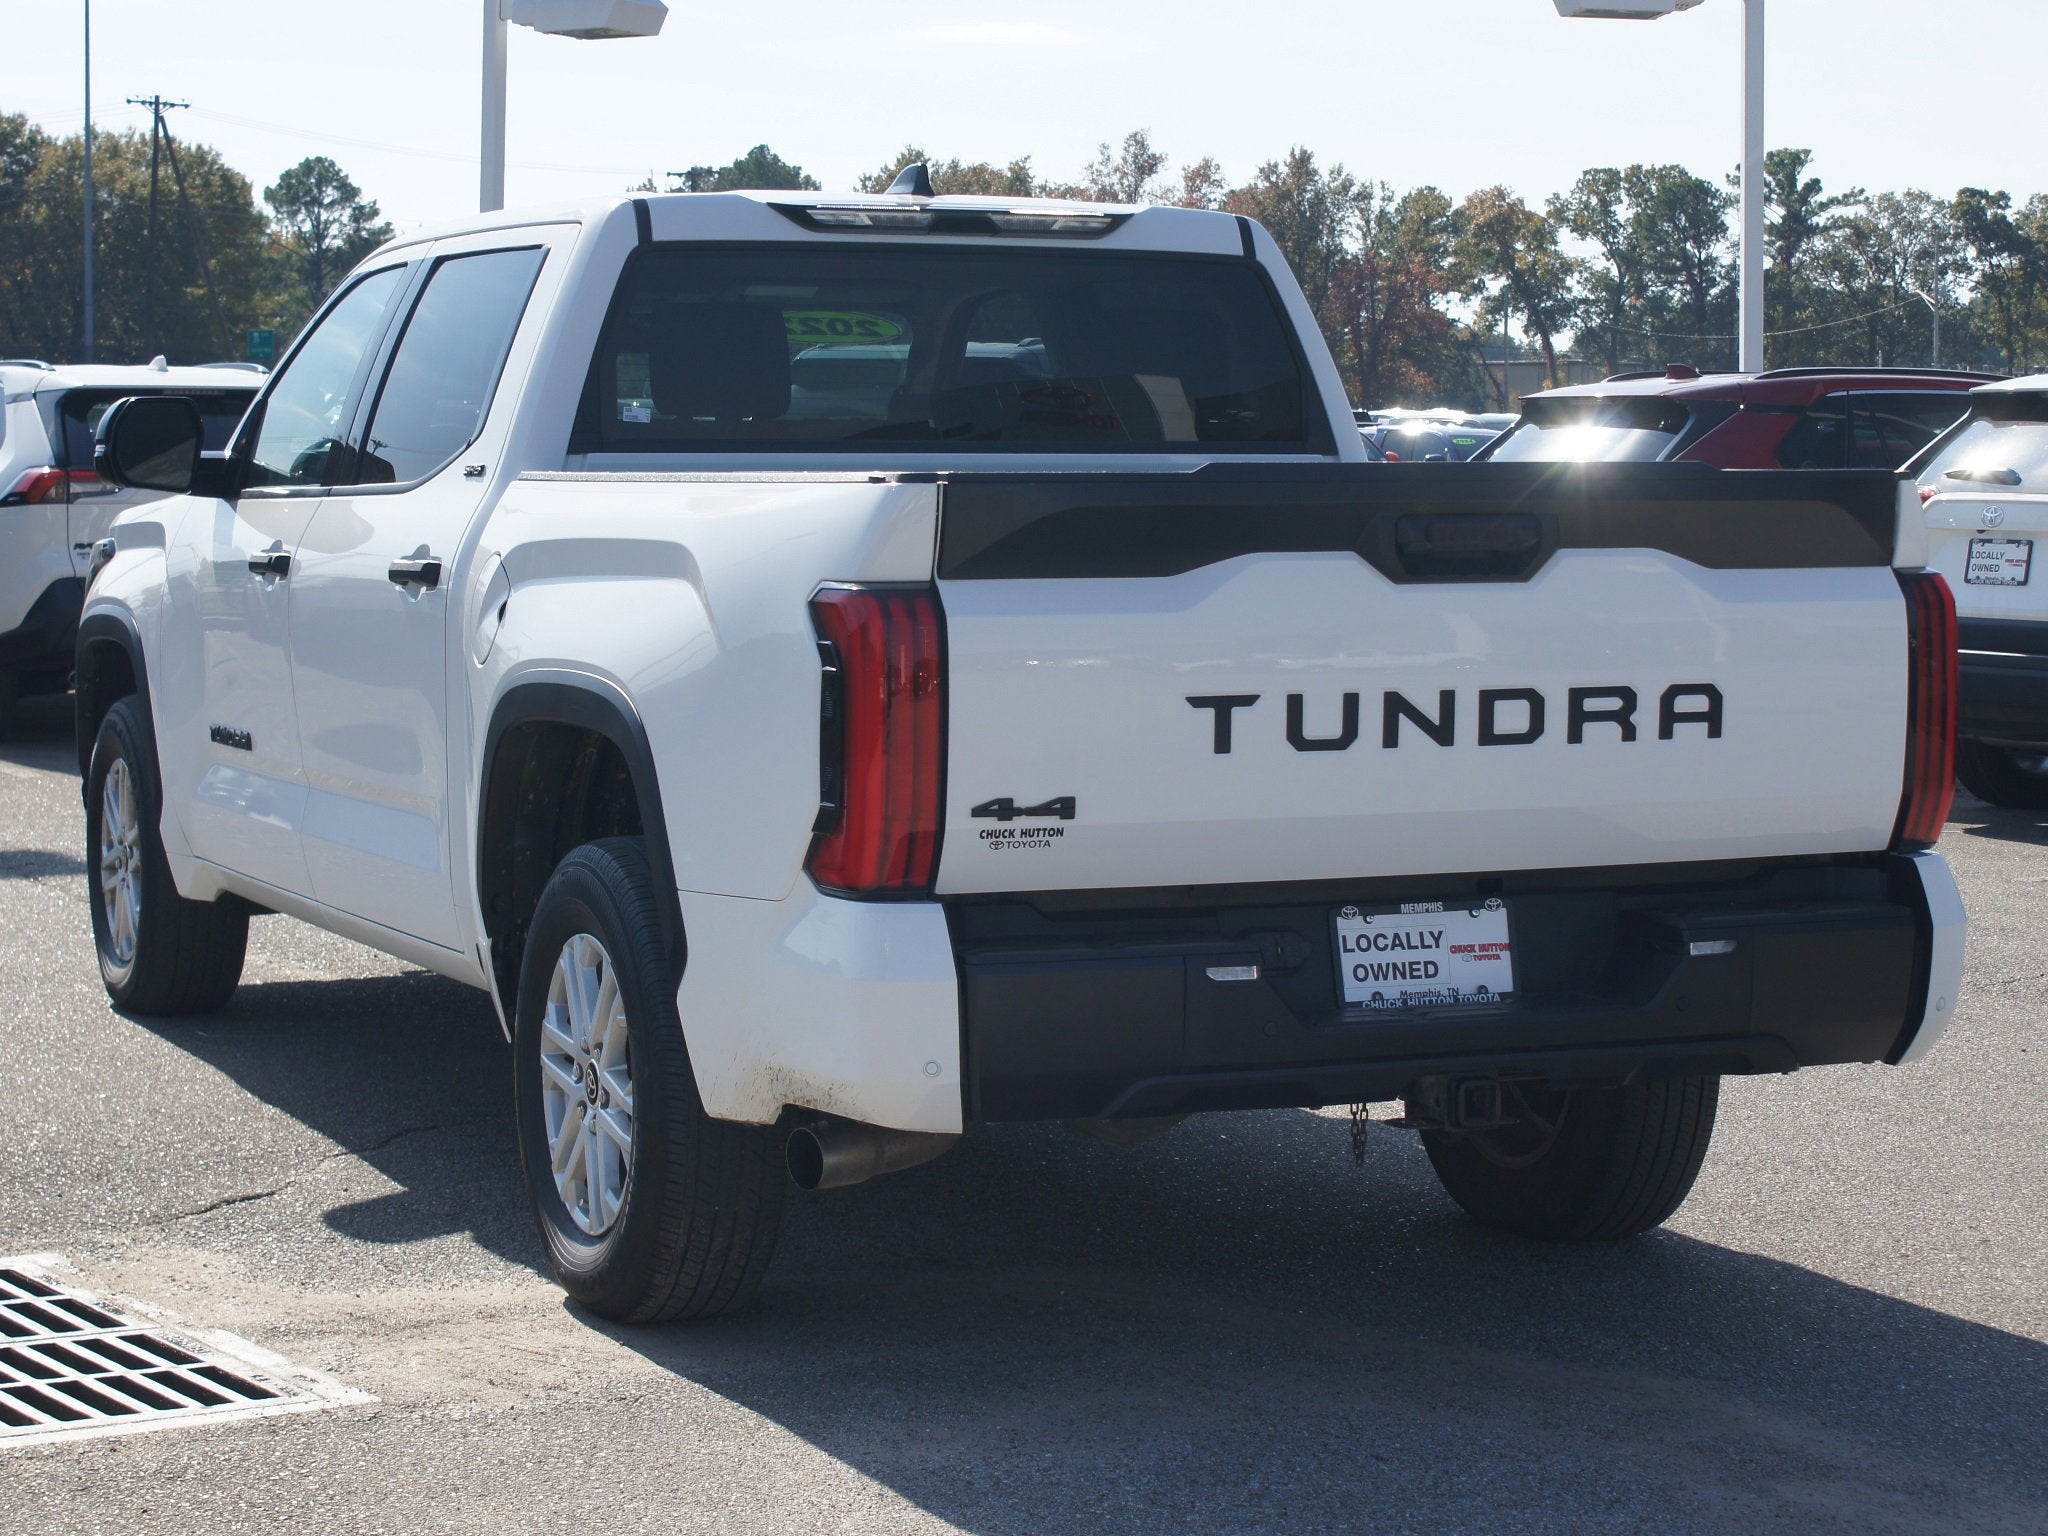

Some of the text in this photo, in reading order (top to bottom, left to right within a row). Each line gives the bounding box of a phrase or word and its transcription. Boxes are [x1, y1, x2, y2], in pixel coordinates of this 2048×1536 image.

[1970, 551, 2005, 560] LOCALLY
[1971, 563, 2000, 573] OWNED
[1184, 682, 1723, 755] TUNDRA
[979, 827, 1065, 839] CHUCK HUTTON
[1006, 840, 1051, 849] TOYOTA
[1401, 901, 1444, 914] MEMPHIS
[1341, 930, 1444, 953] LOCALLY
[1449, 942, 1512, 954] CHUCK HUTTON
[1472, 953, 1502, 962] TOYOTA
[1352, 960, 1439, 983] OWNED
[1447, 987, 1460, 996] TN
[1362, 993, 1501, 1009] CHUCK HUTTON TOYOTA
